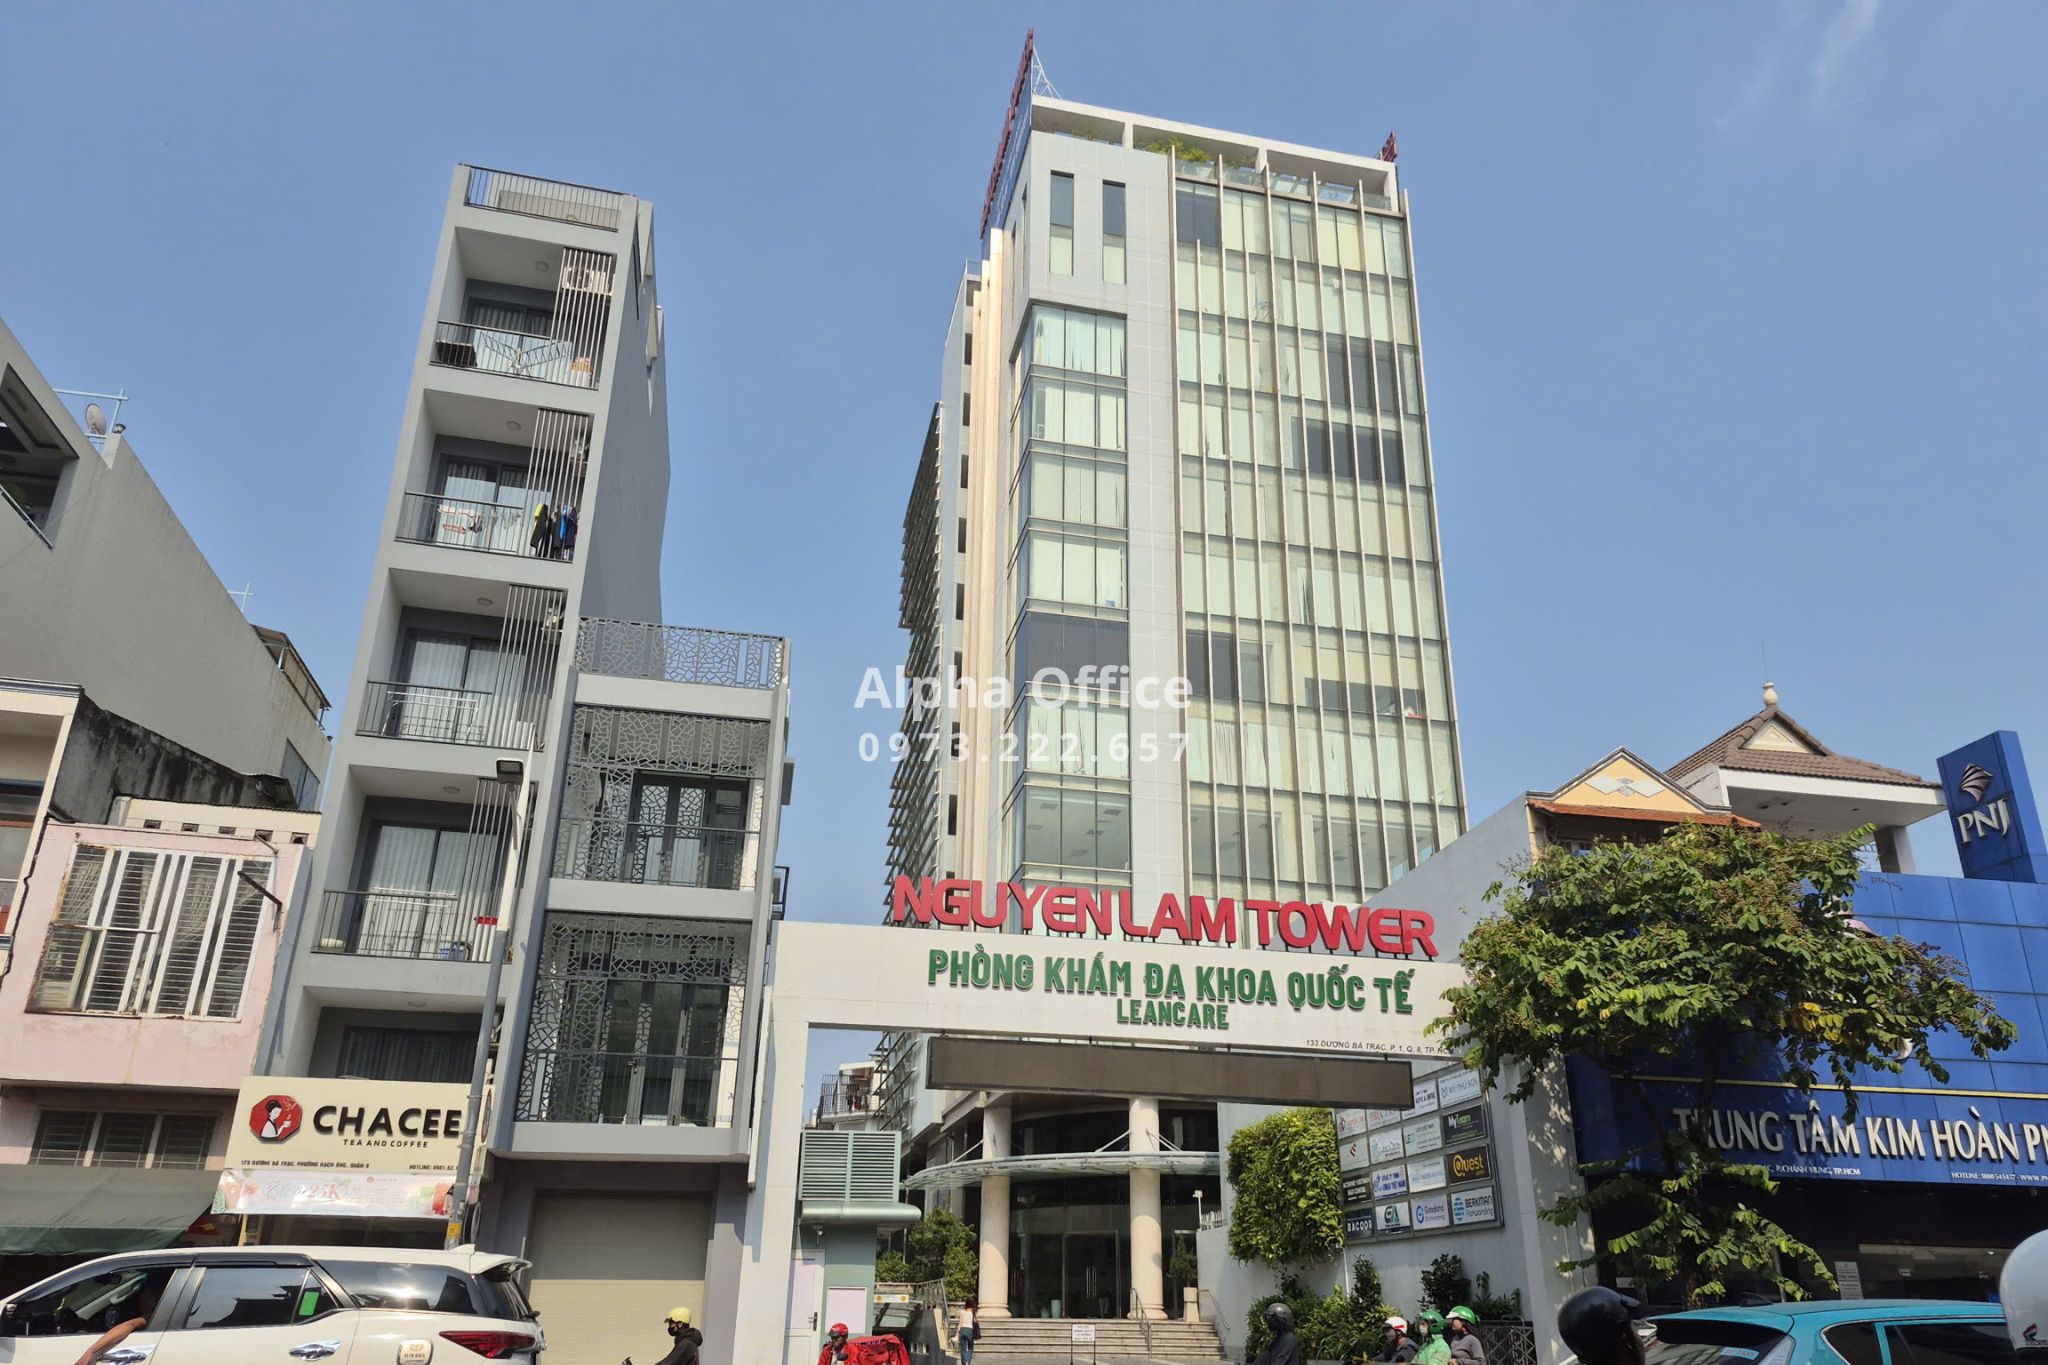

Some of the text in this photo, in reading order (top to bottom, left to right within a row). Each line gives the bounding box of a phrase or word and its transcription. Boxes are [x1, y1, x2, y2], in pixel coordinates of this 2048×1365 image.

[1957, 798, 2011, 843] PNJ
[1245, 899, 1439, 957] TOWER
[928, 943, 1415, 1015] PHÒNG KHÁM ĐA KHOA QUỐC TẾ
[1117, 998, 1230, 1031] LEANCARE
[1321, 1040, 1350, 1049] DƯƠNG
[313, 1105, 462, 1138] CHACEE
[1789, 1100, 1861, 1155] TÂM
[1866, 1116, 1926, 1157] KIM
[1930, 1105, 2020, 1161] HOÀN
[343, 1139, 362, 1147] TEA
[390, 1140, 428, 1148] COFFEE
[1453, 1154, 1484, 1177] Quest
[1465, 1195, 1492, 1208] BERKMAN
